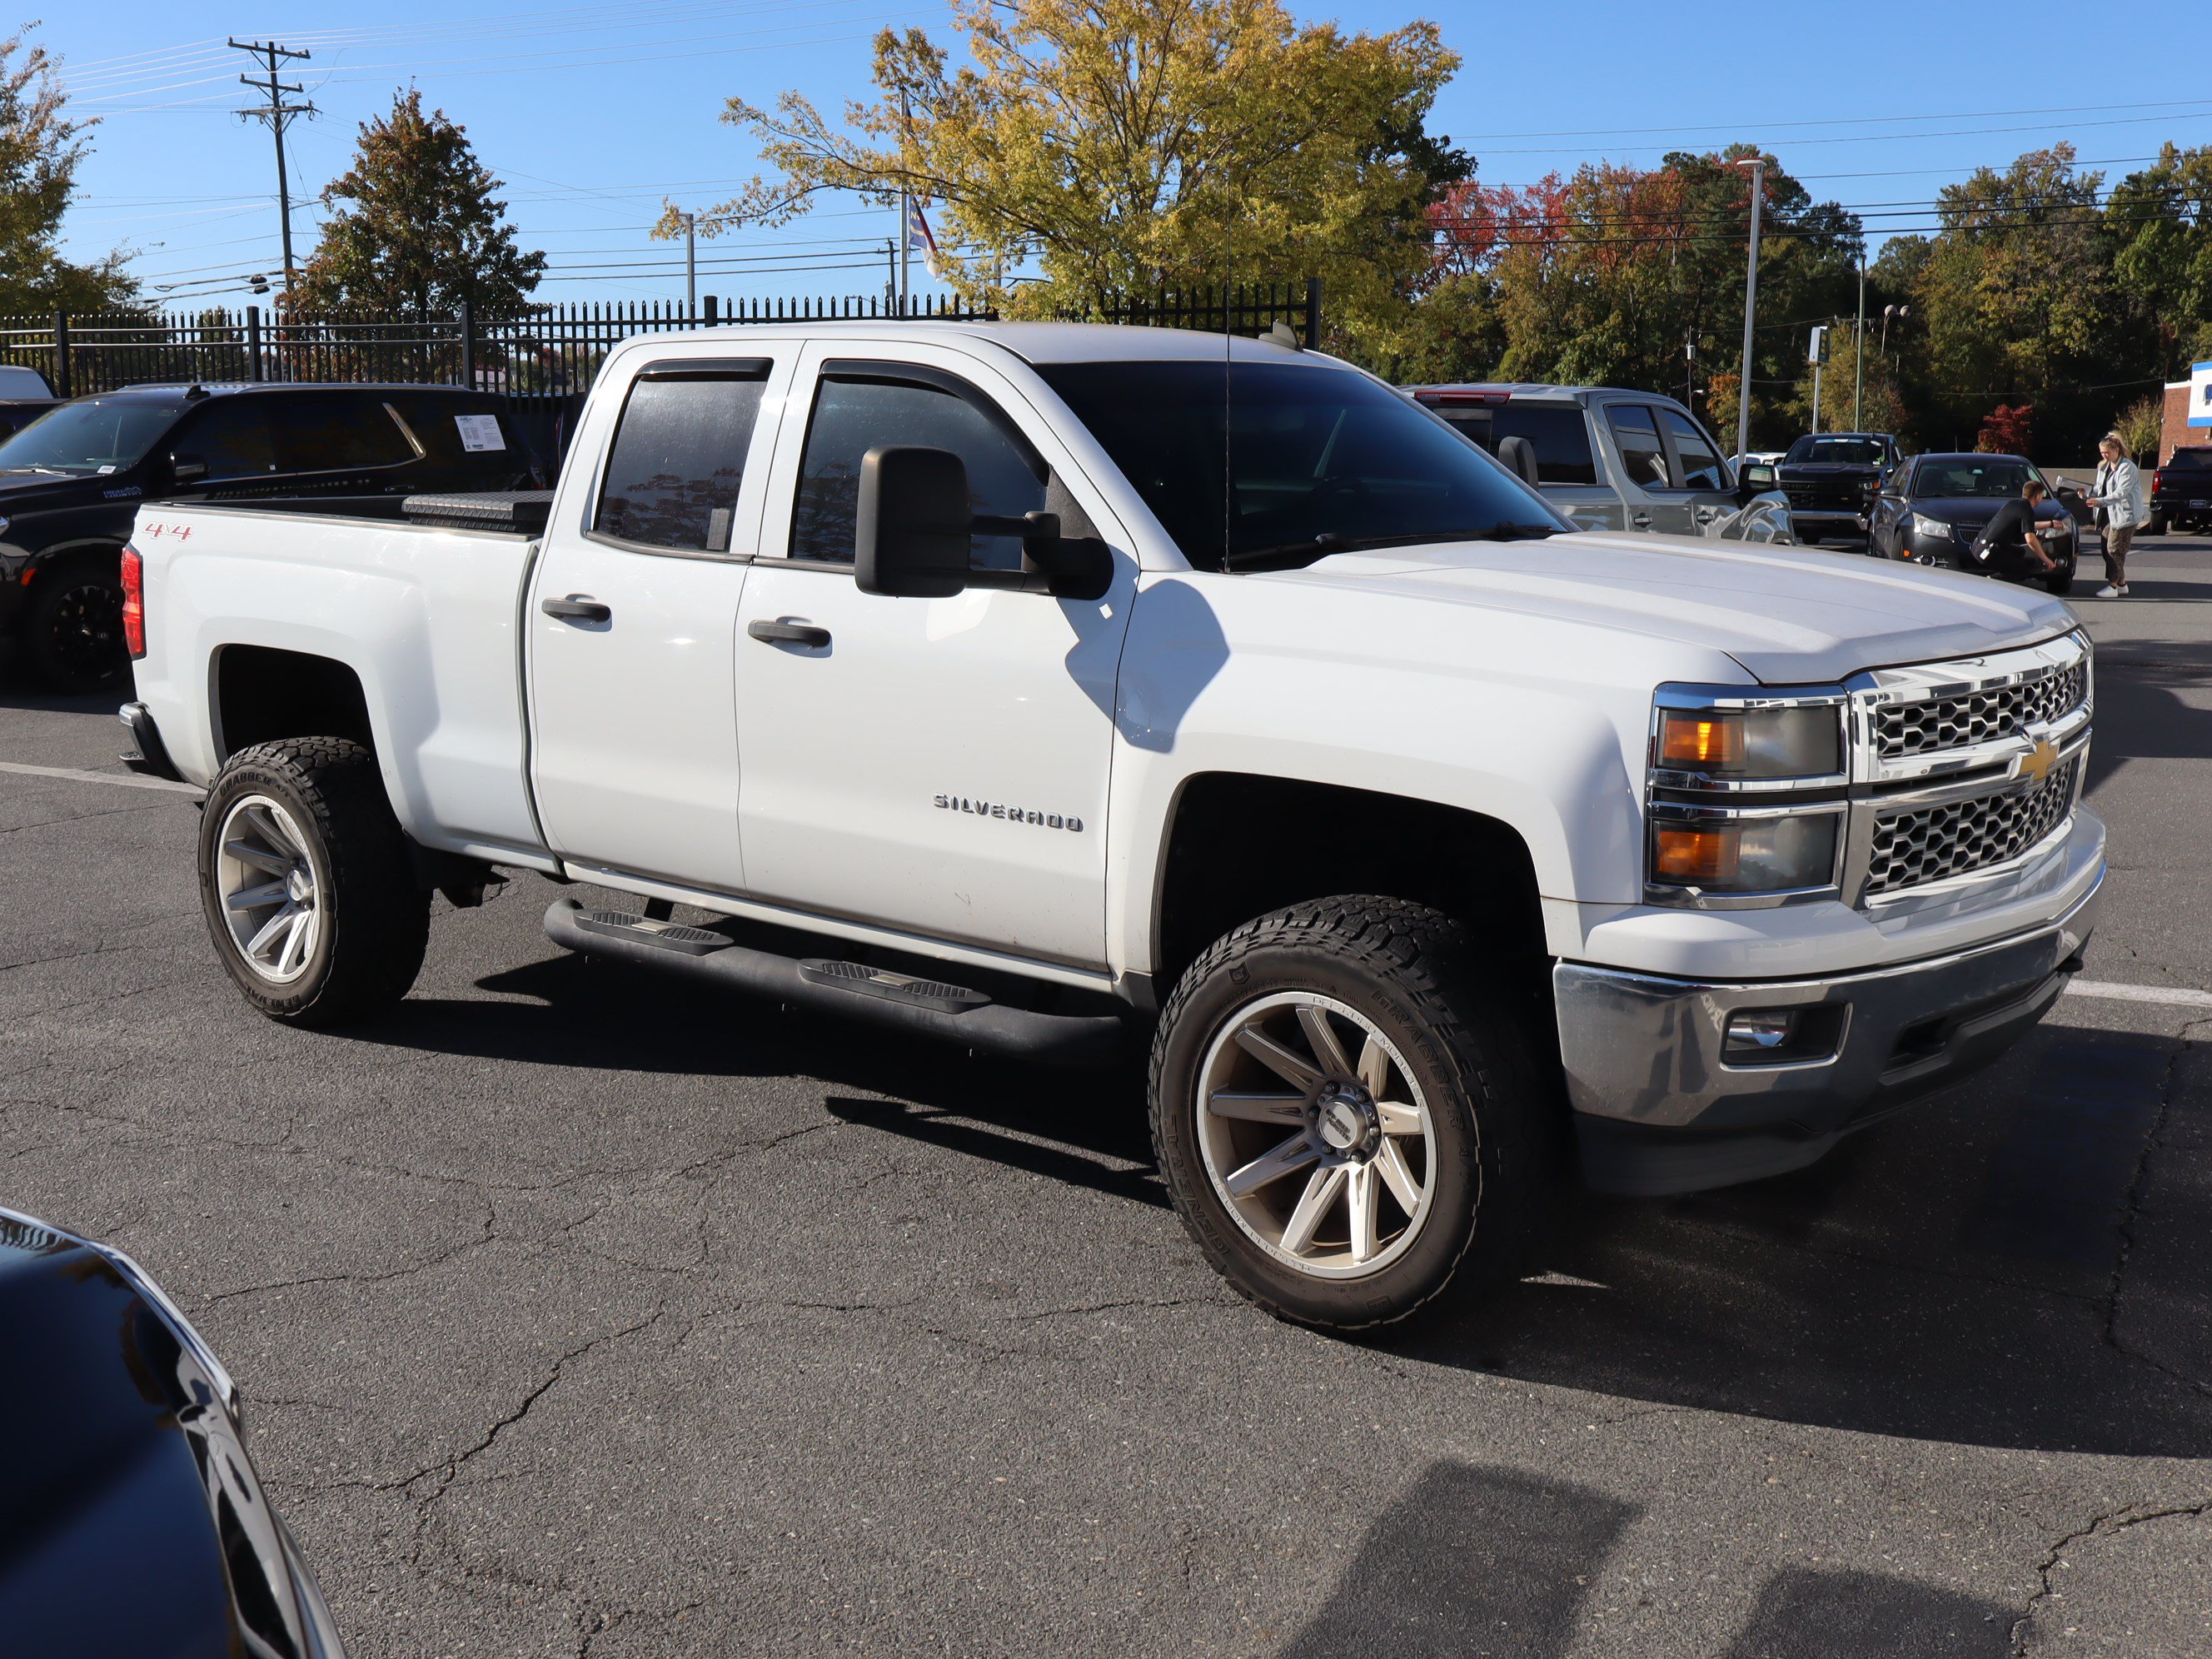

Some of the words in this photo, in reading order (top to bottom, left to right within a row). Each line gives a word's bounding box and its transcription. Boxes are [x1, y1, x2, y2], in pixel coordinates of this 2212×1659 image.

[219, 772, 272, 796] GRABBER
[933, 792, 1084, 832] SILVERADO
[1373, 989, 1465, 1131] GRABBER
[1166, 1113, 1230, 1256] GENERAL
